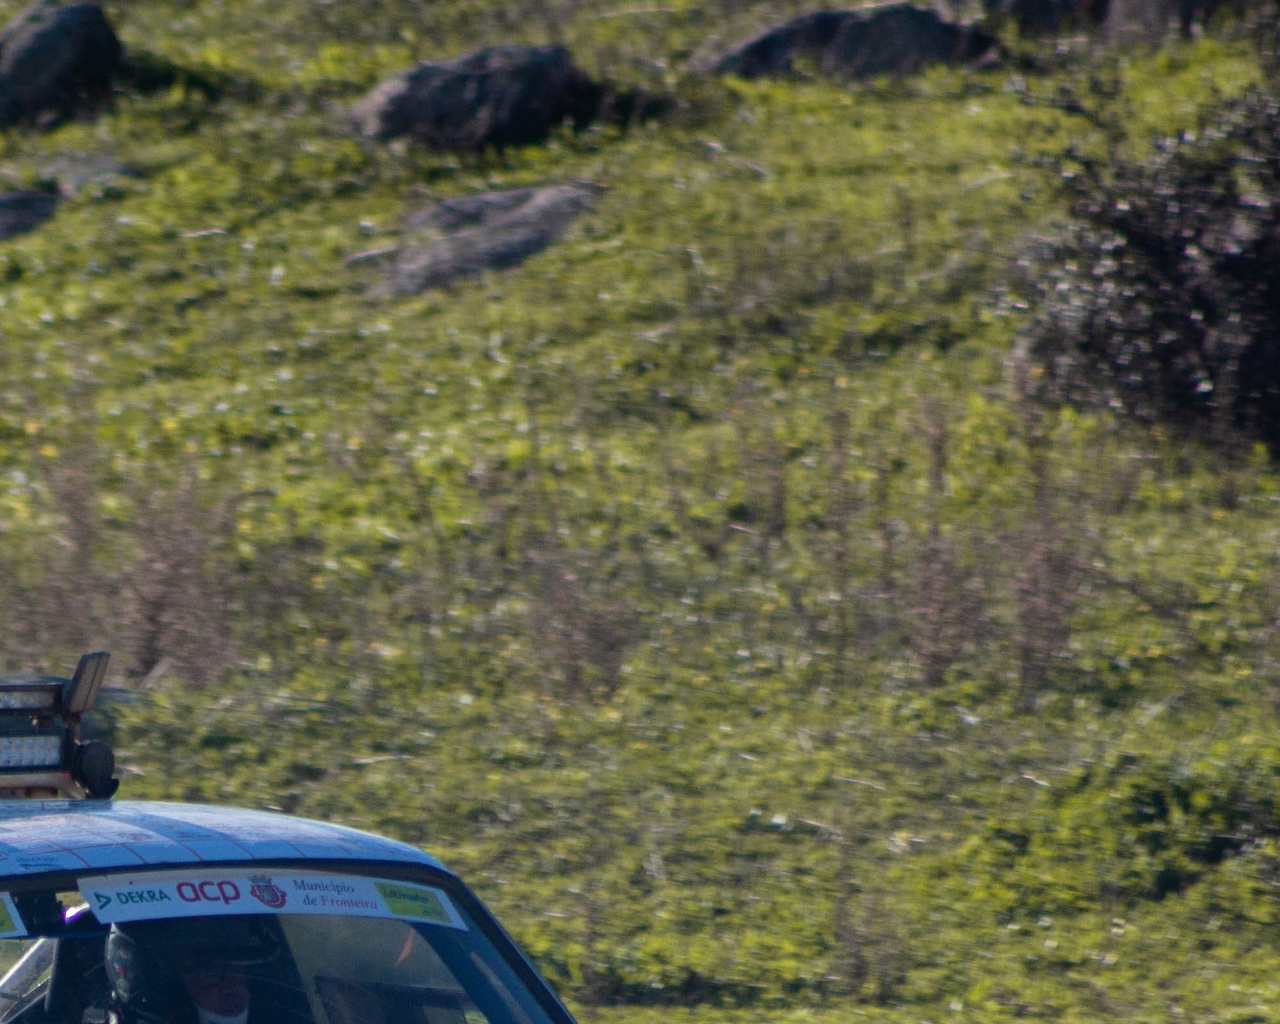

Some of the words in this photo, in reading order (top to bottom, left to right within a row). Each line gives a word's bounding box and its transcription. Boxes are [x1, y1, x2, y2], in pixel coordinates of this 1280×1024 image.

[115, 889, 172, 905] DEKRA
[175, 881, 242, 905] acp
[302, 895, 319, 907] de
[320, 895, 379, 910] Fronteira
